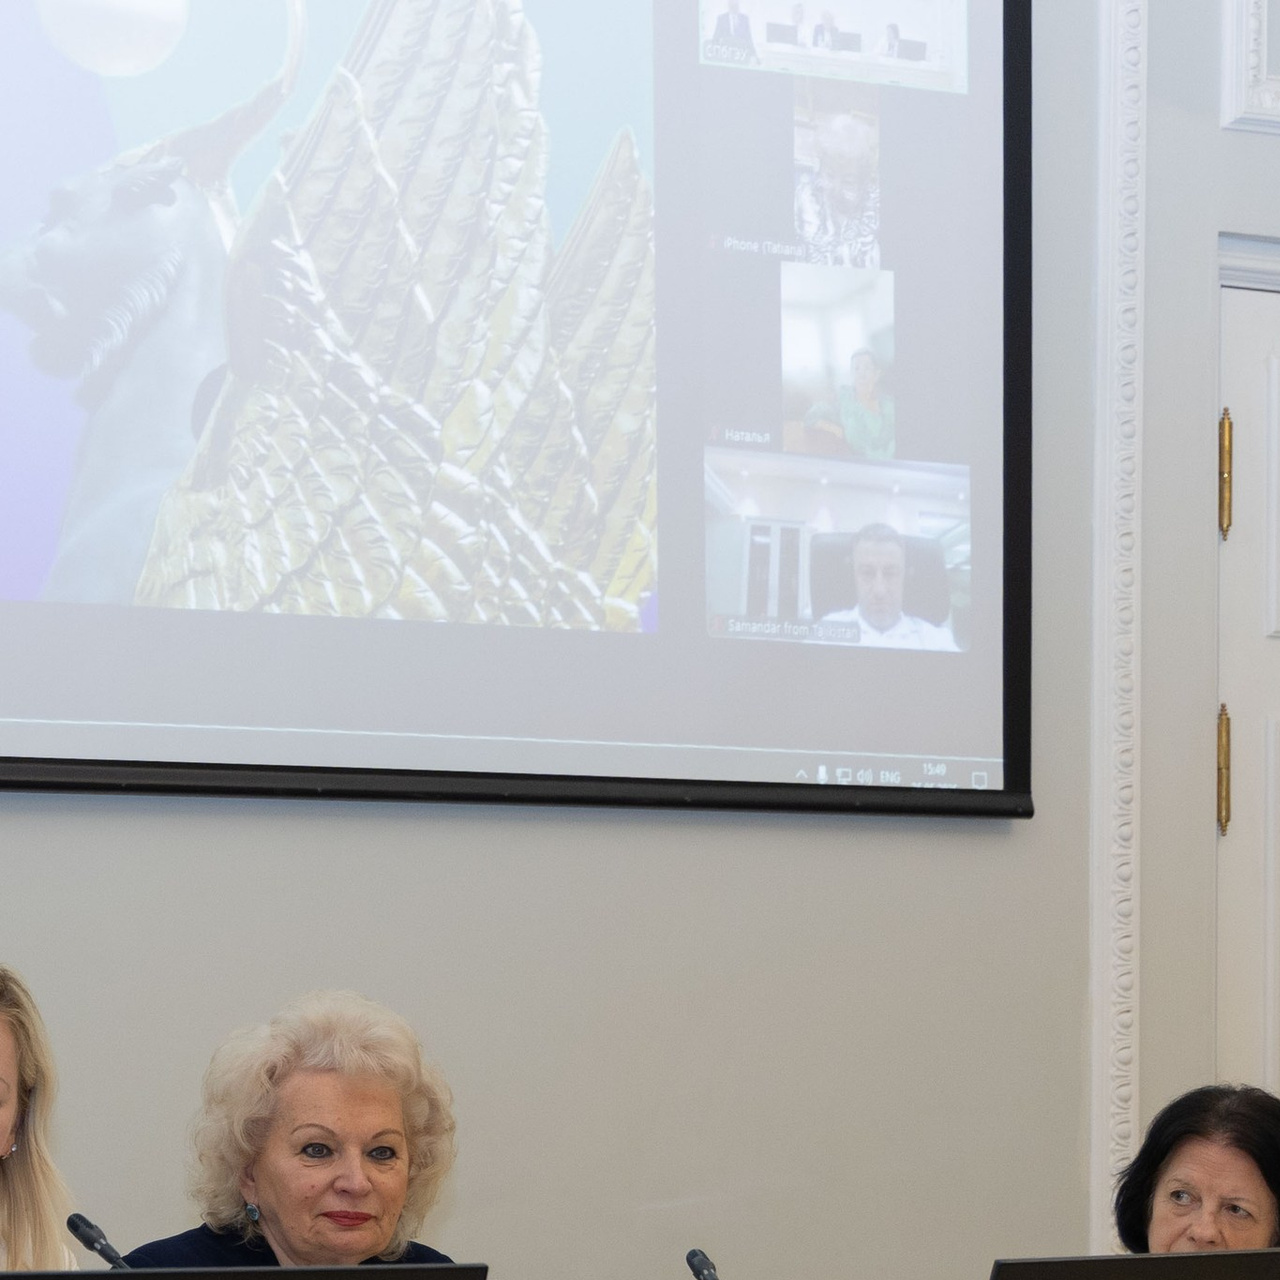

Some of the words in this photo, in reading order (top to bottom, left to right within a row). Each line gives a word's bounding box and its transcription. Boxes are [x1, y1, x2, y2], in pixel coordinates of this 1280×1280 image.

[723, 236, 759, 252] iPhone
[724, 428, 771, 444] Наталья
[727, 618, 781, 634] Samandar
[783, 621, 809, 636] from
[880, 769, 902, 785] ENG
